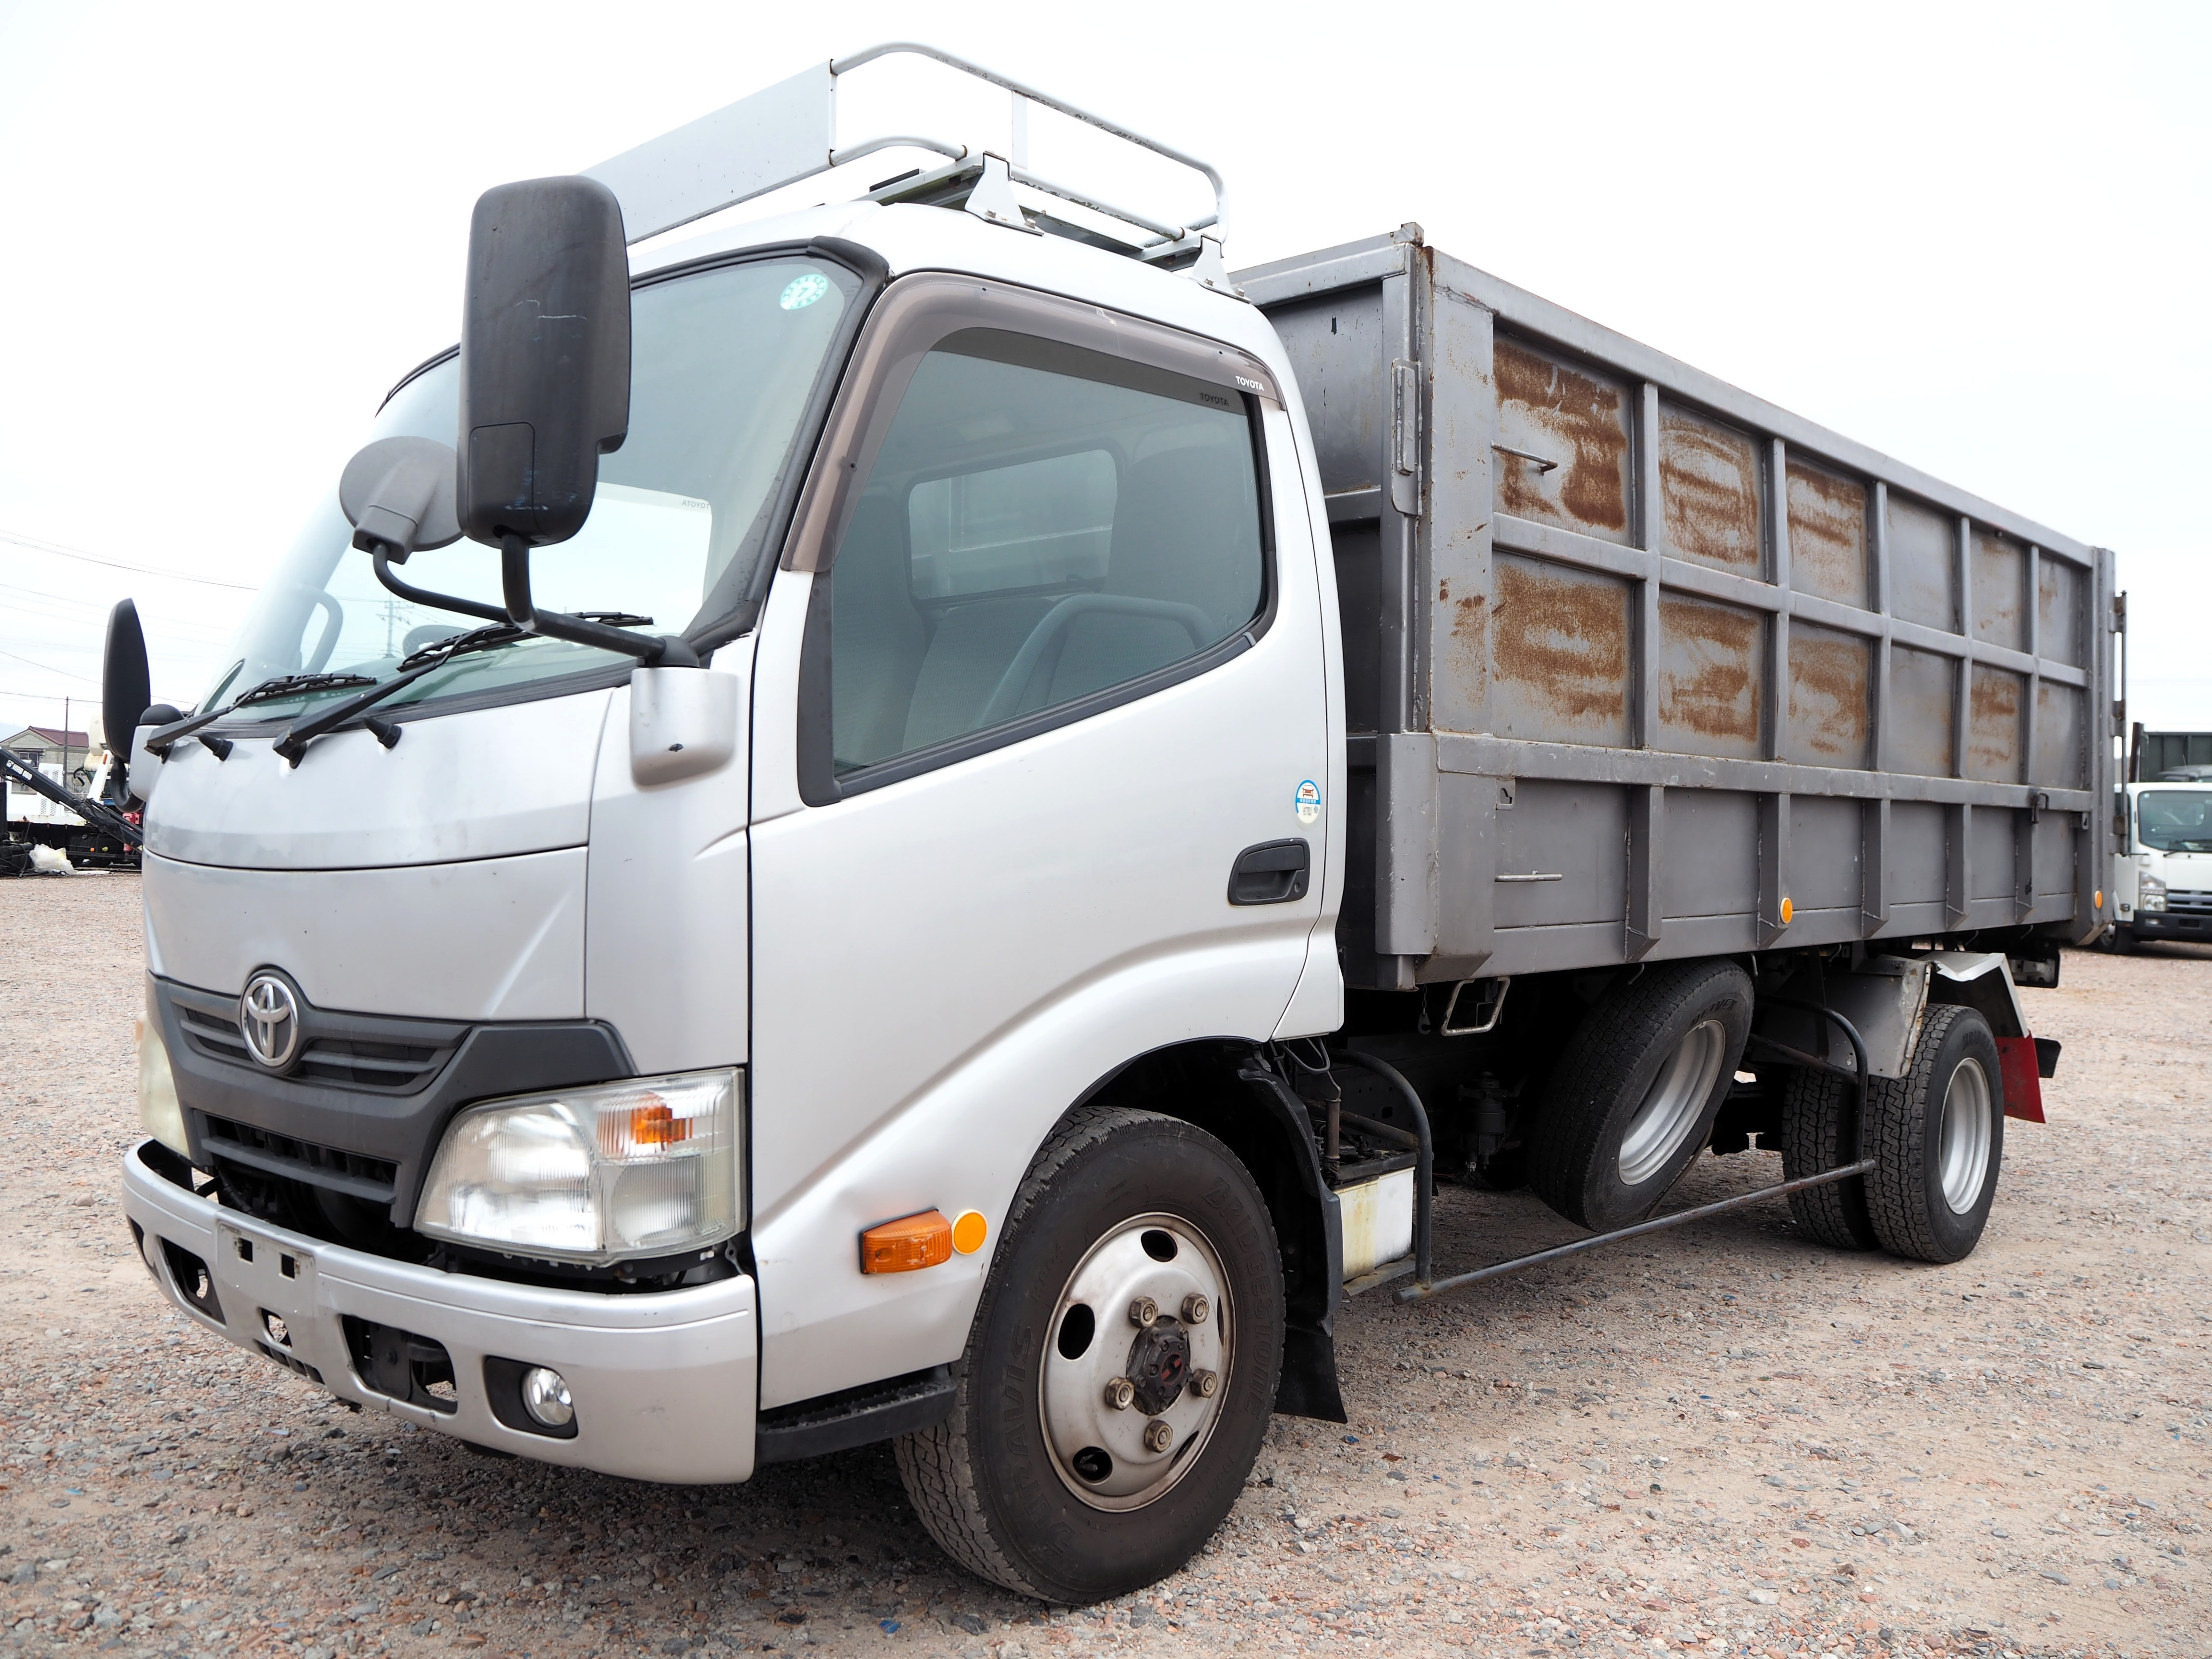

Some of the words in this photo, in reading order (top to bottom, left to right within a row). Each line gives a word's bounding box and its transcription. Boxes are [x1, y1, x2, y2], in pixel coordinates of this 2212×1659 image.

[797, 287, 809, 298] 7
[1235, 375, 1264, 391] TOYOTA
[1200, 392, 1229, 406] TOYOTA
[1203, 1177, 1273, 1419] BRIDGESTONE
